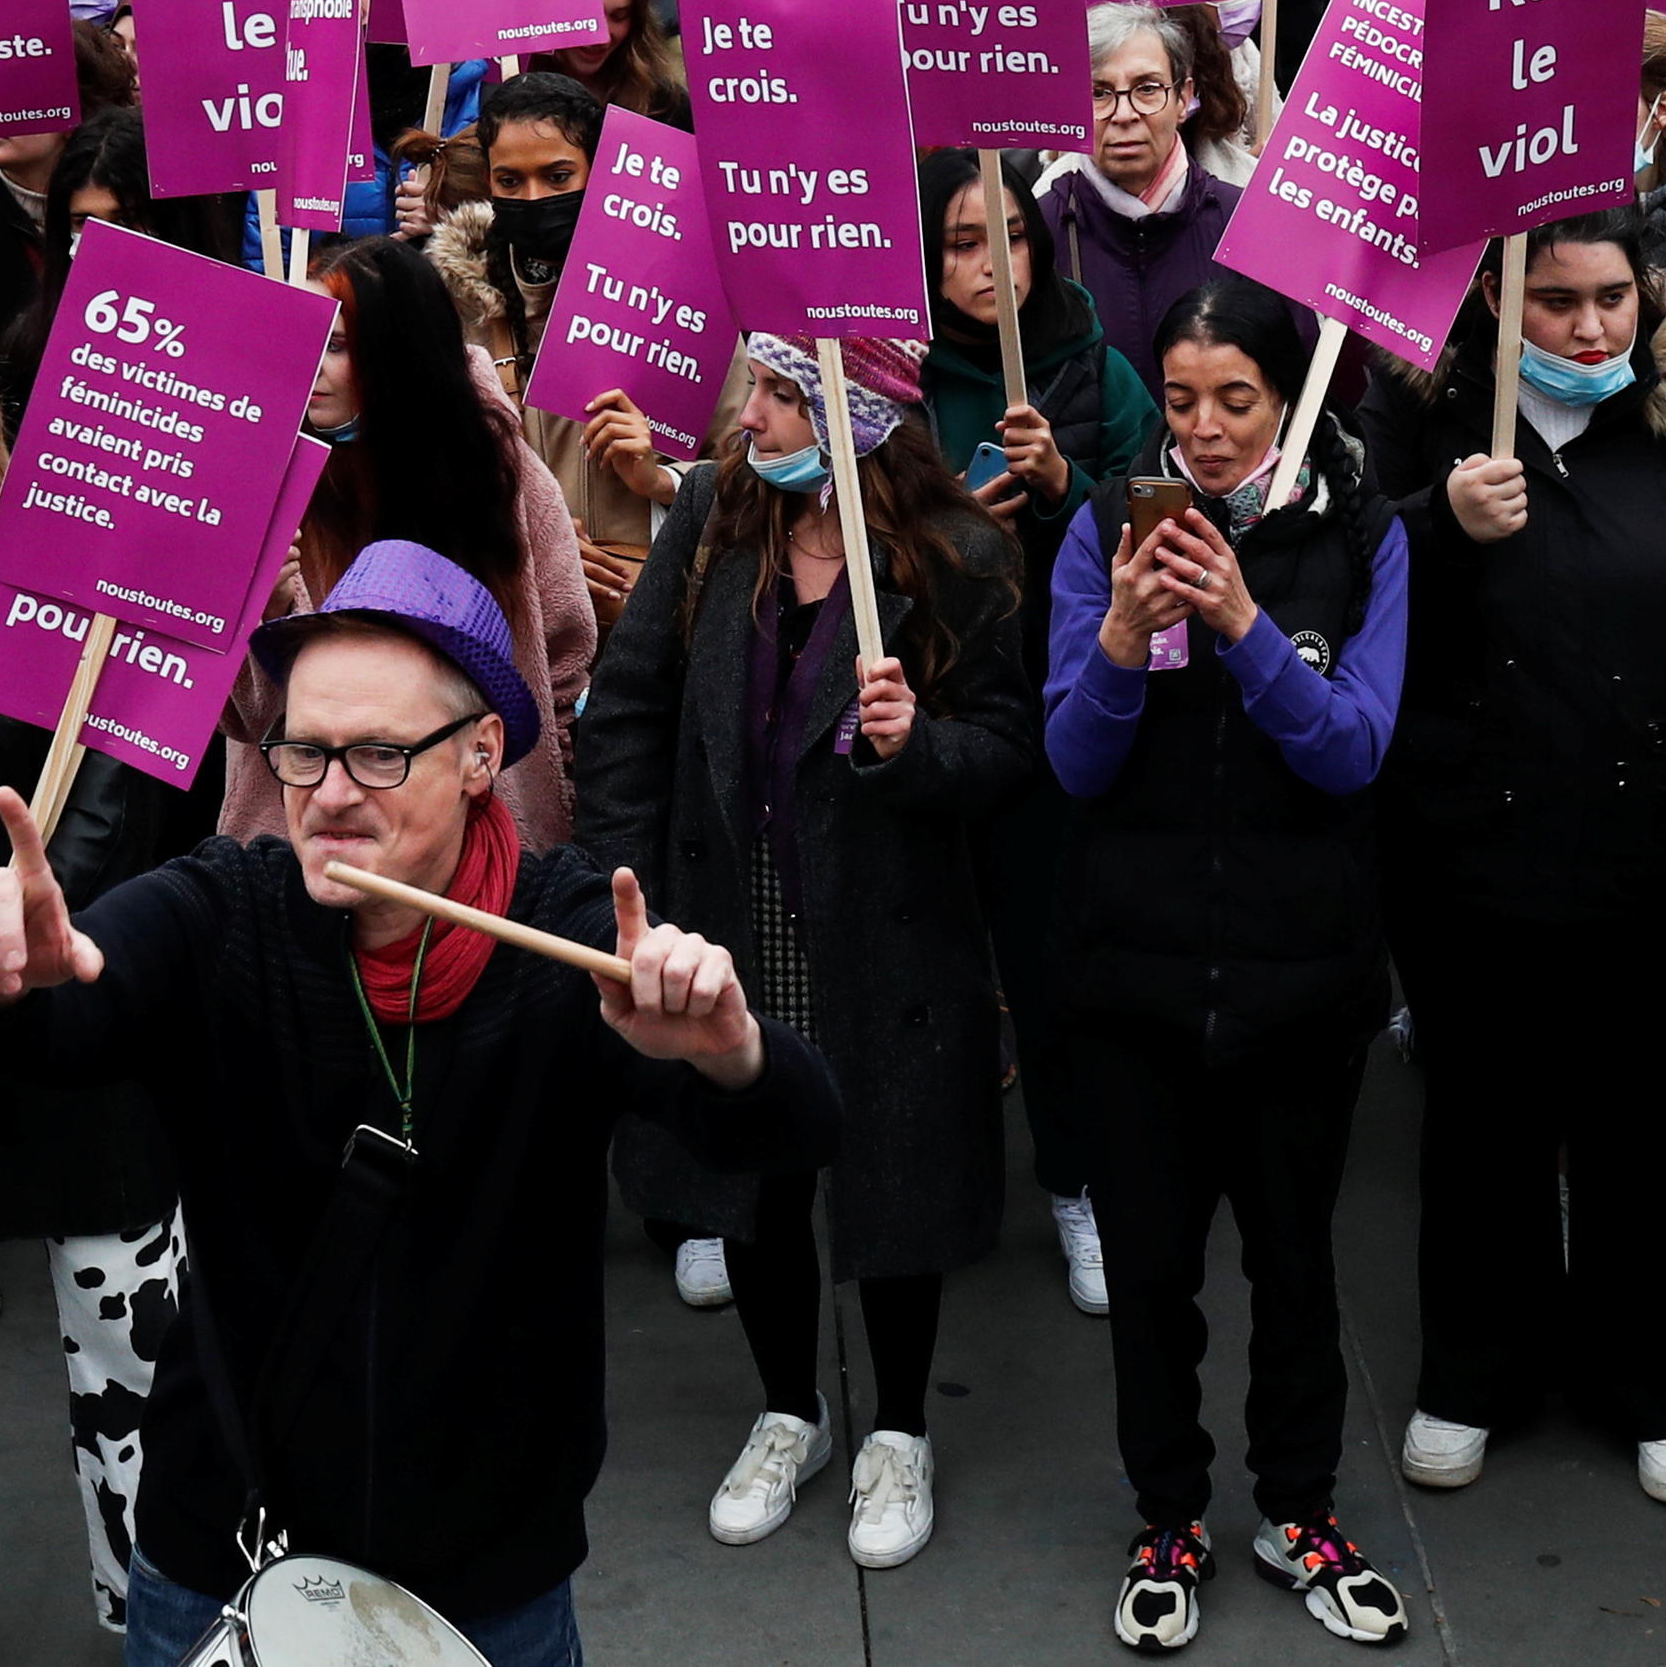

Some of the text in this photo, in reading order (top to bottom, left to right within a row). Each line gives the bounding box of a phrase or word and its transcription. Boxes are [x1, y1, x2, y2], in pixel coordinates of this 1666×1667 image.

[703, 17, 772, 54] Je te
[709, 69, 797, 103] crois.
[1513, 39, 1556, 90] le
[1479, 105, 1578, 178] viol
[719, 162, 868, 204] Tu n'y es
[728, 215, 891, 253] pour rien.
[85, 290, 185, 357] 65%
[71, 343, 262, 422] des victimes de
[61, 376, 204, 442] féminicides
[49, 418, 193, 477] avaient pris
[22, 482, 114, 529] justice.
[38, 453, 221, 525] contact avec la
[305, 1588, 341, 1598] REMO
